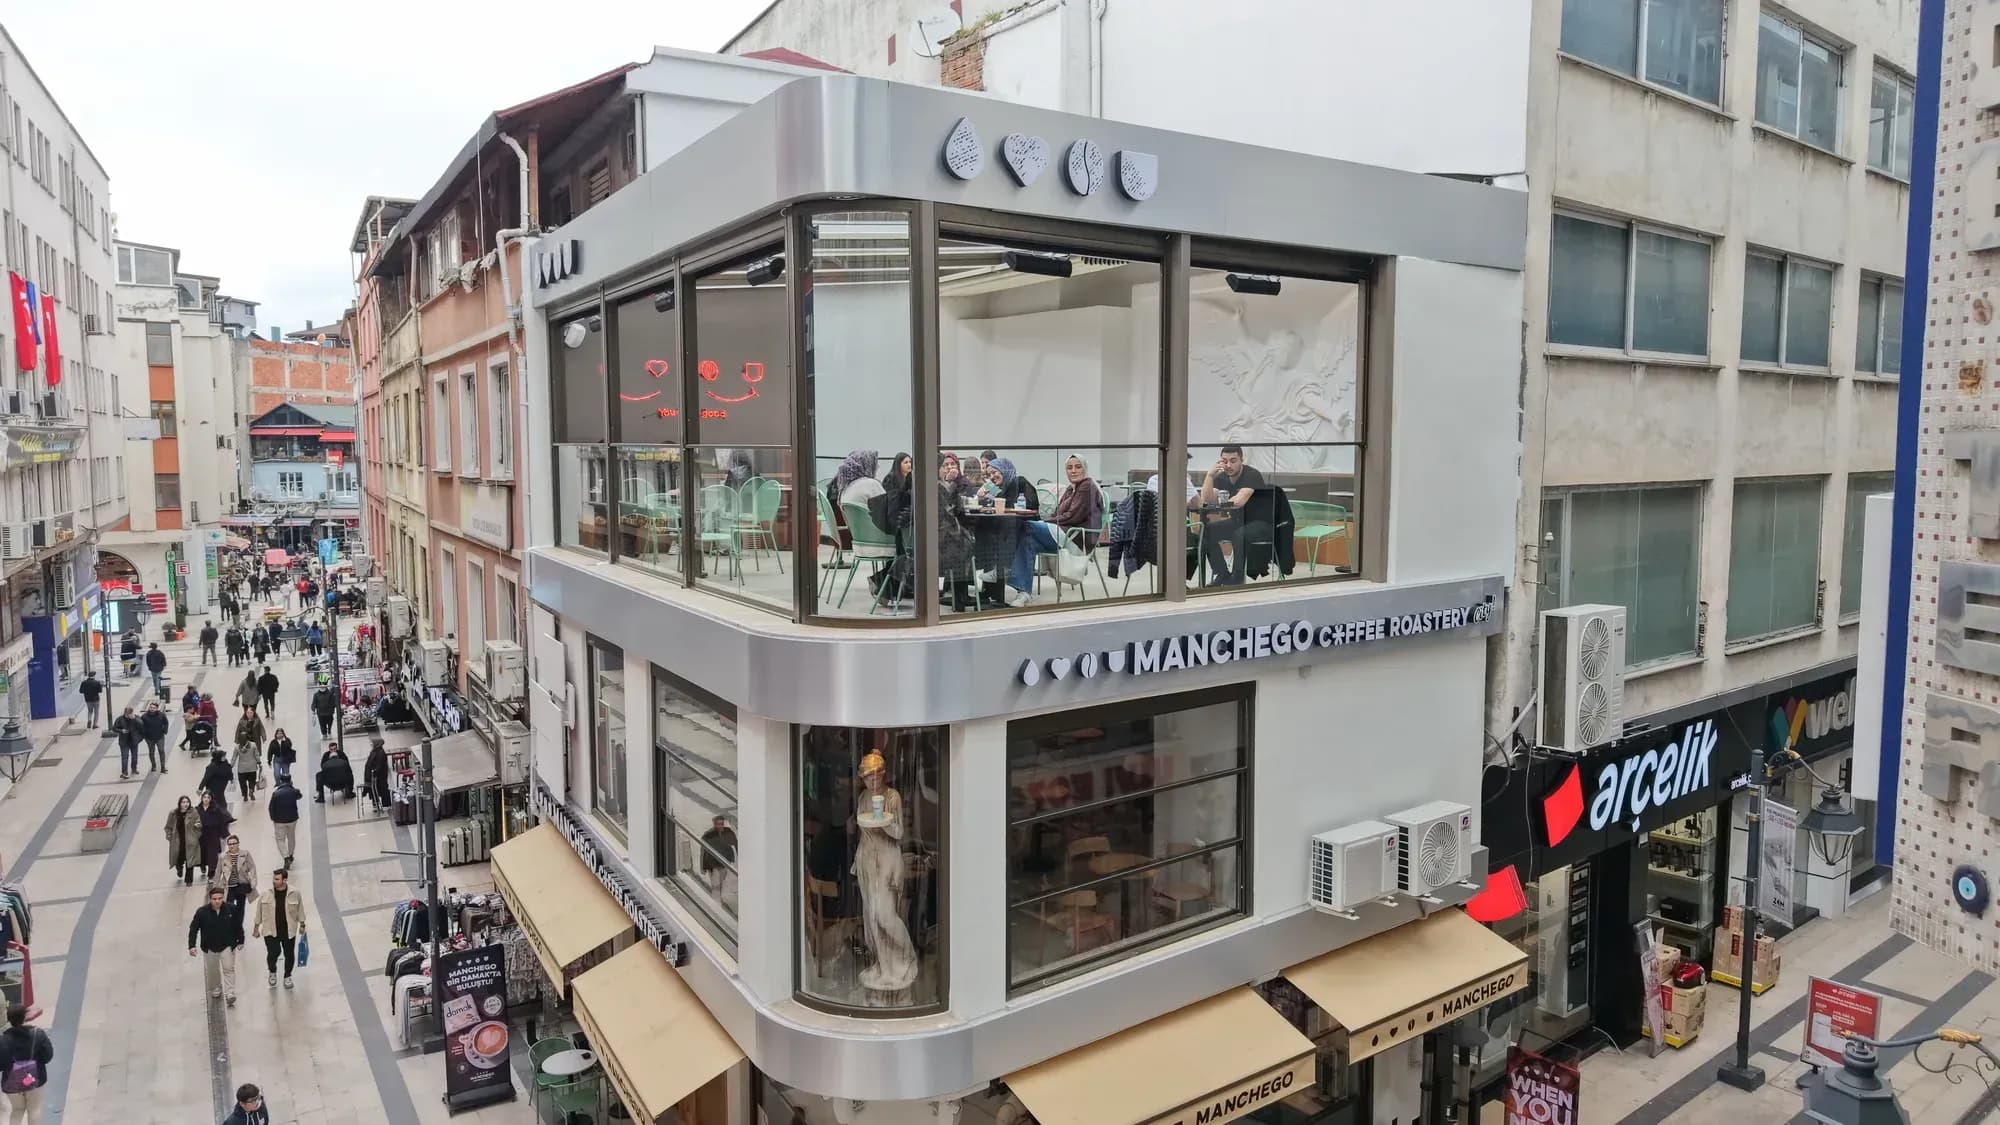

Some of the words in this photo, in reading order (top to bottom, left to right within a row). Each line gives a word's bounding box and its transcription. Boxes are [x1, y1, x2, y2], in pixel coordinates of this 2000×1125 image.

[1133, 620, 1313, 676] MANCHEGO
[1389, 606, 1470, 638] ROASTERY
[1590, 719, 1718, 833] arçelik
[553, 802, 598, 873] MANCHEGO
[448, 963, 497, 978] MANCHEGO
[1442, 973, 1514, 1018] MANCHEGO
[1195, 1071, 1294, 1125] MANCHEGO
[1510, 1070, 1573, 1110] WHEN
[1511, 1088, 1572, 1125] YOU
